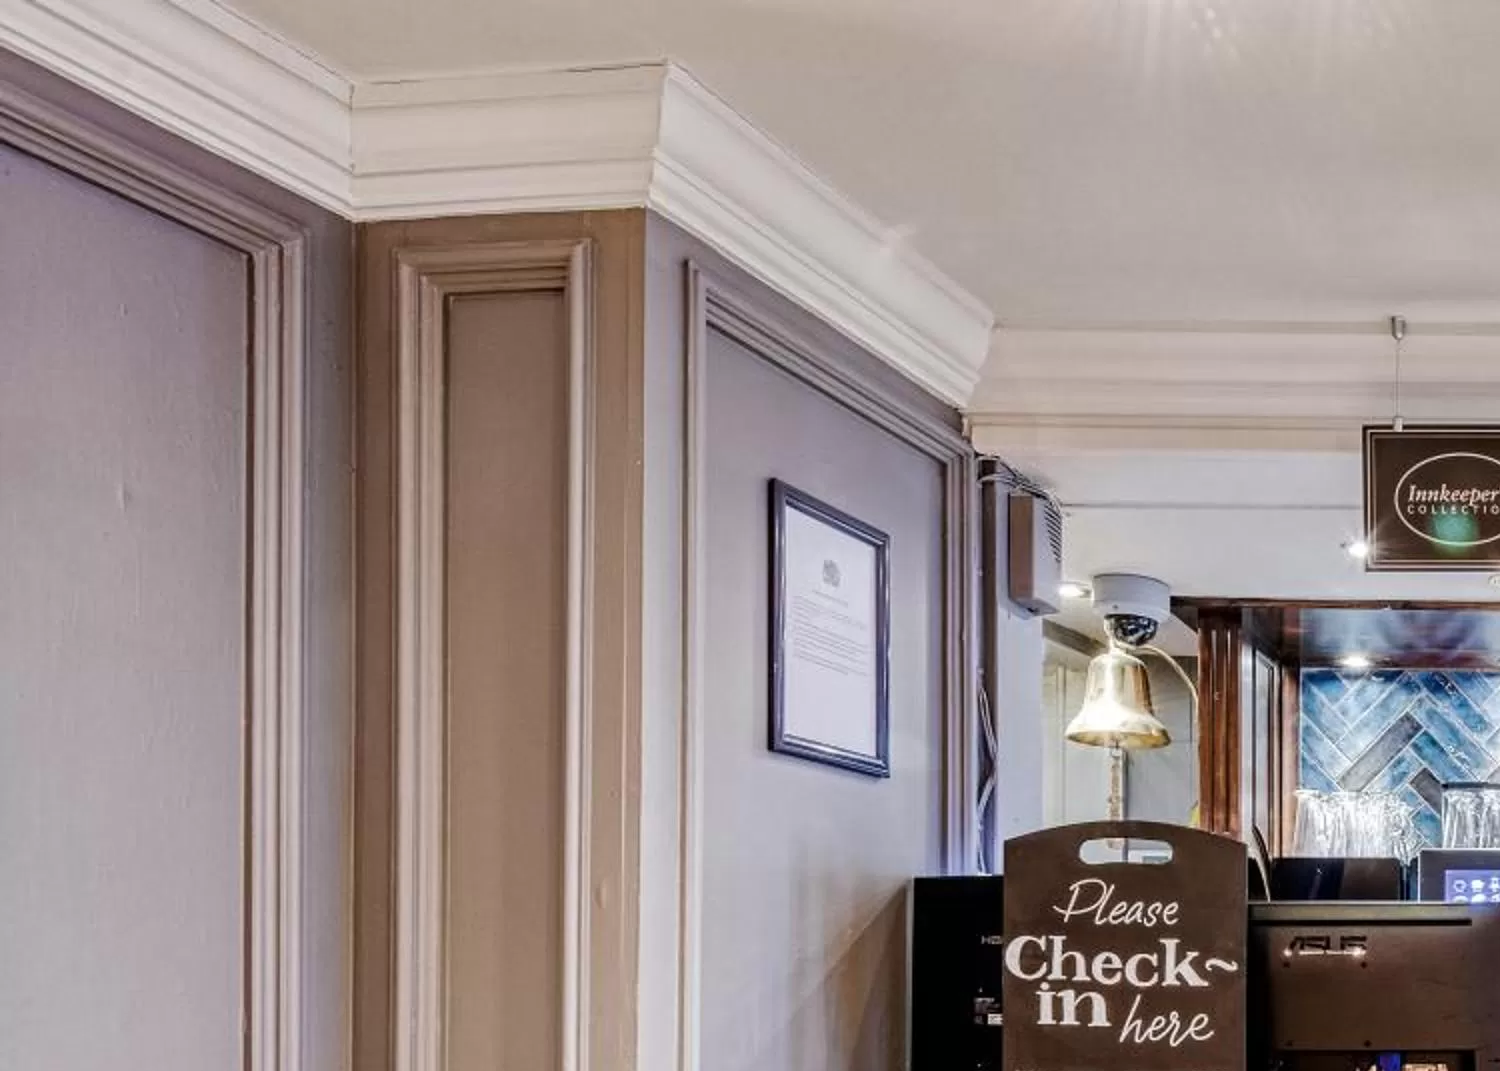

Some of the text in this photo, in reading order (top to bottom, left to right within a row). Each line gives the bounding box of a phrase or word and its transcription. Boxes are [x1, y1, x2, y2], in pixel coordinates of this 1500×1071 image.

[1052, 878, 1180, 927] Please
[1283, 935, 1367, 956] ASUS
[1035, 982, 1112, 1028] in
[1119, 994, 1216, 1047] here
